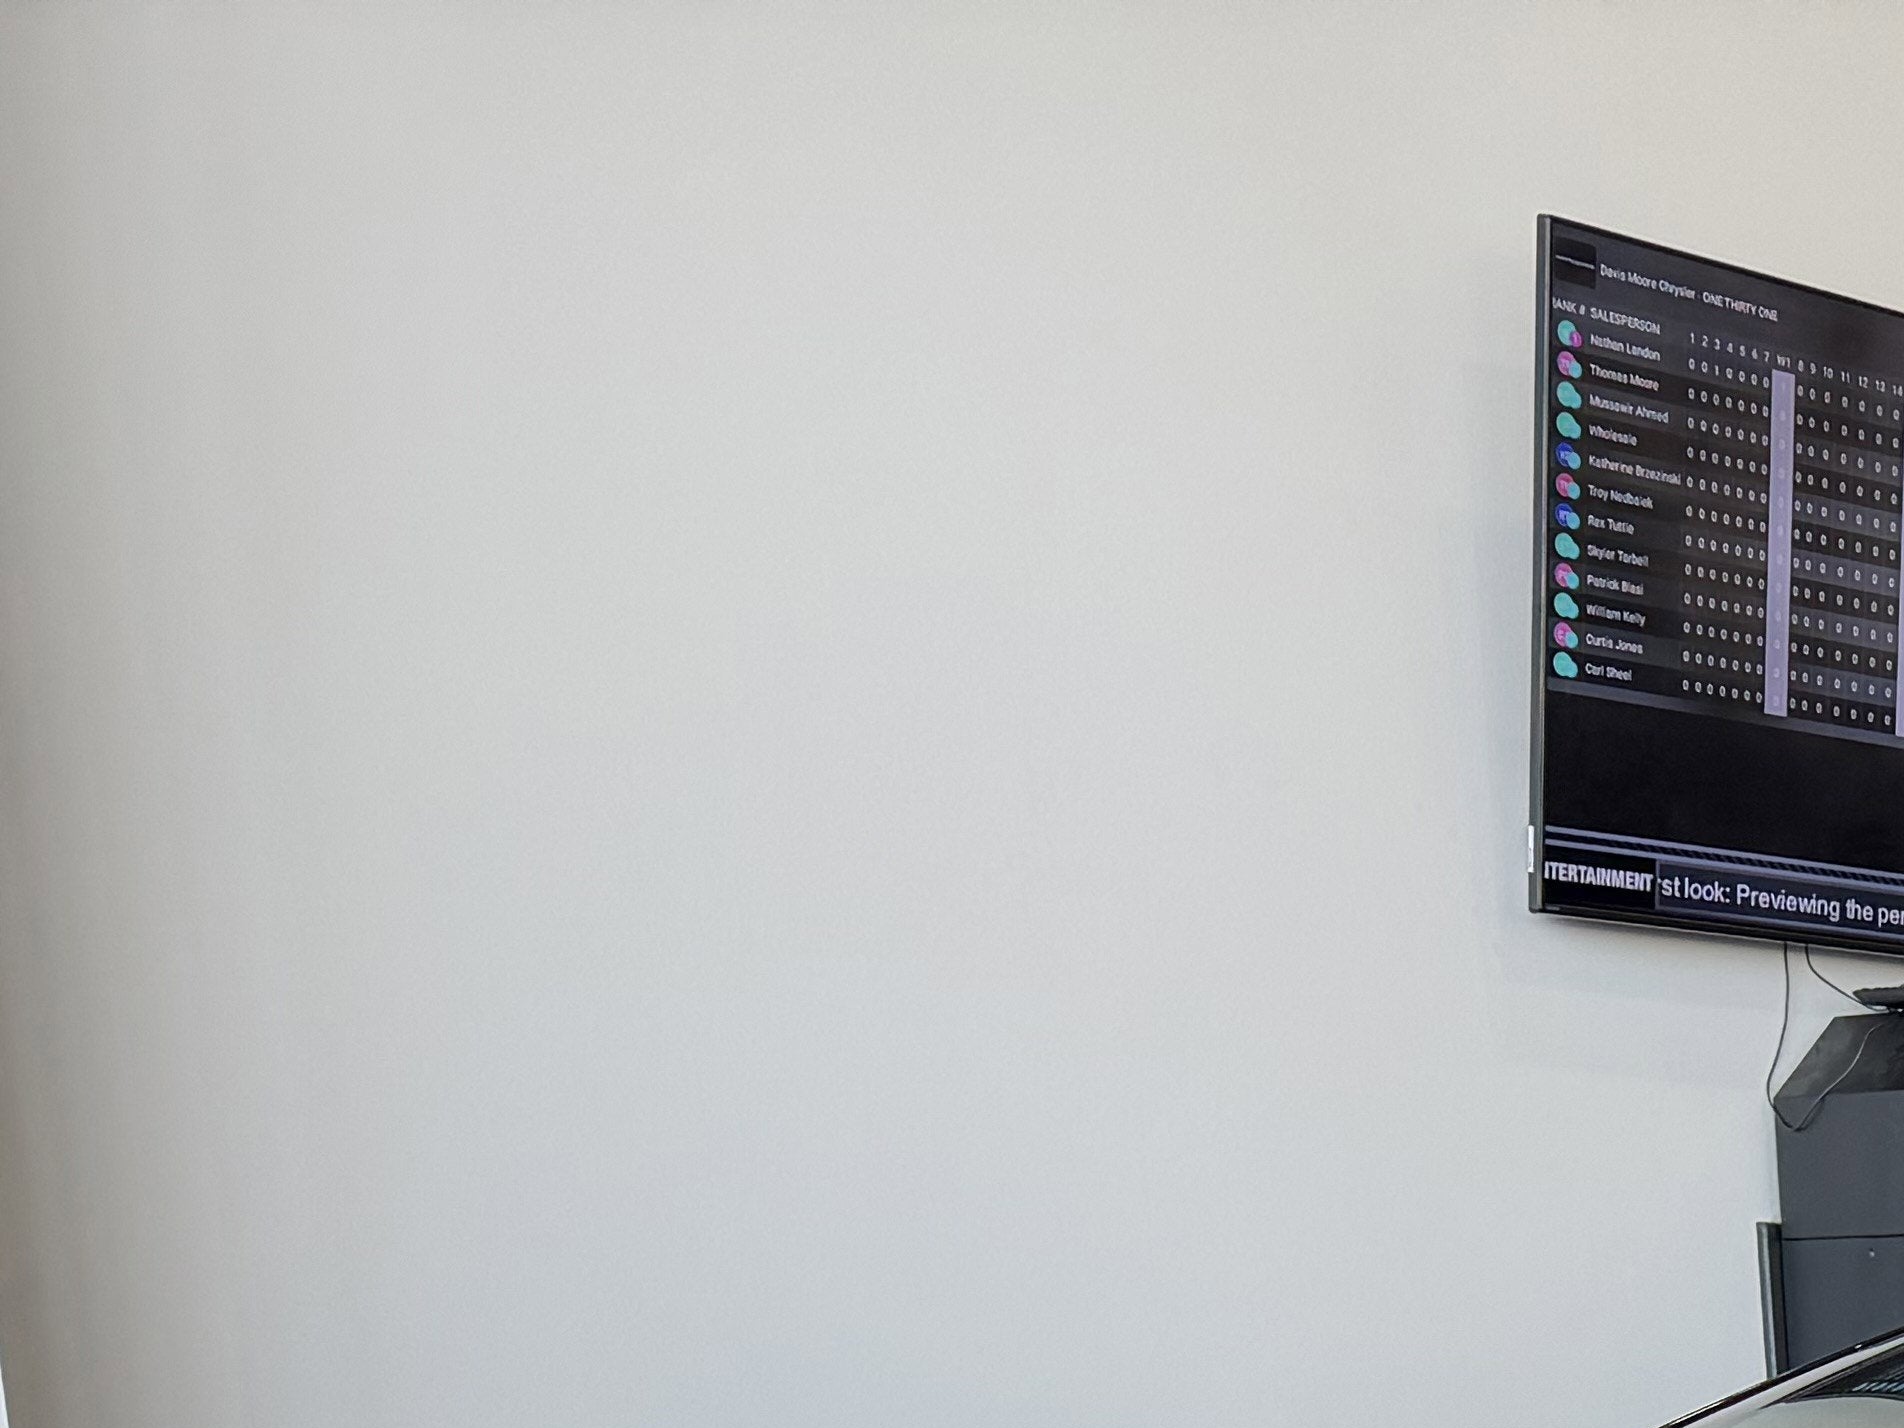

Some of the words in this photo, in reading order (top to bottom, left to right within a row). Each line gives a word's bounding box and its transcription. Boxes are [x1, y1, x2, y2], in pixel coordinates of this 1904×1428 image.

[1627, 270, 1657, 290] Moore
[1658, 278, 1695, 301] Chrysler
[1702, 290, 1722, 308] ONE
[1722, 295, 1757, 317] THIRTY
[1757, 305, 1778, 323] ONE
[1589, 306, 1661, 336] SALESPERSON
[1589, 332, 1624, 354] Nathan
[1589, 362, 1628, 385] Thomas
[1629, 372, 1660, 392] Moore
[1635, 404, 1669, 424] Ahmed
[1588, 423, 1637, 447] Wholesale
[1588, 453, 1634, 475] Katherine
[1587, 483, 1608, 502] Troy
[1587, 513, 1605, 529] Rex
[1586, 572, 1620, 591] Patrick
[1585, 602, 1621, 621] William
[1622, 610, 1646, 628] Kelly
[1585, 632, 1613, 649] Curtis
[1615, 638, 1643, 655] Jones
[1584, 662, 1604, 677] Carl
[1657, 872, 1681, 899] st
[1684, 876, 1731, 906] look:
[1735, 883, 1839, 923] Previewing
[1844, 897, 1873, 923] the
